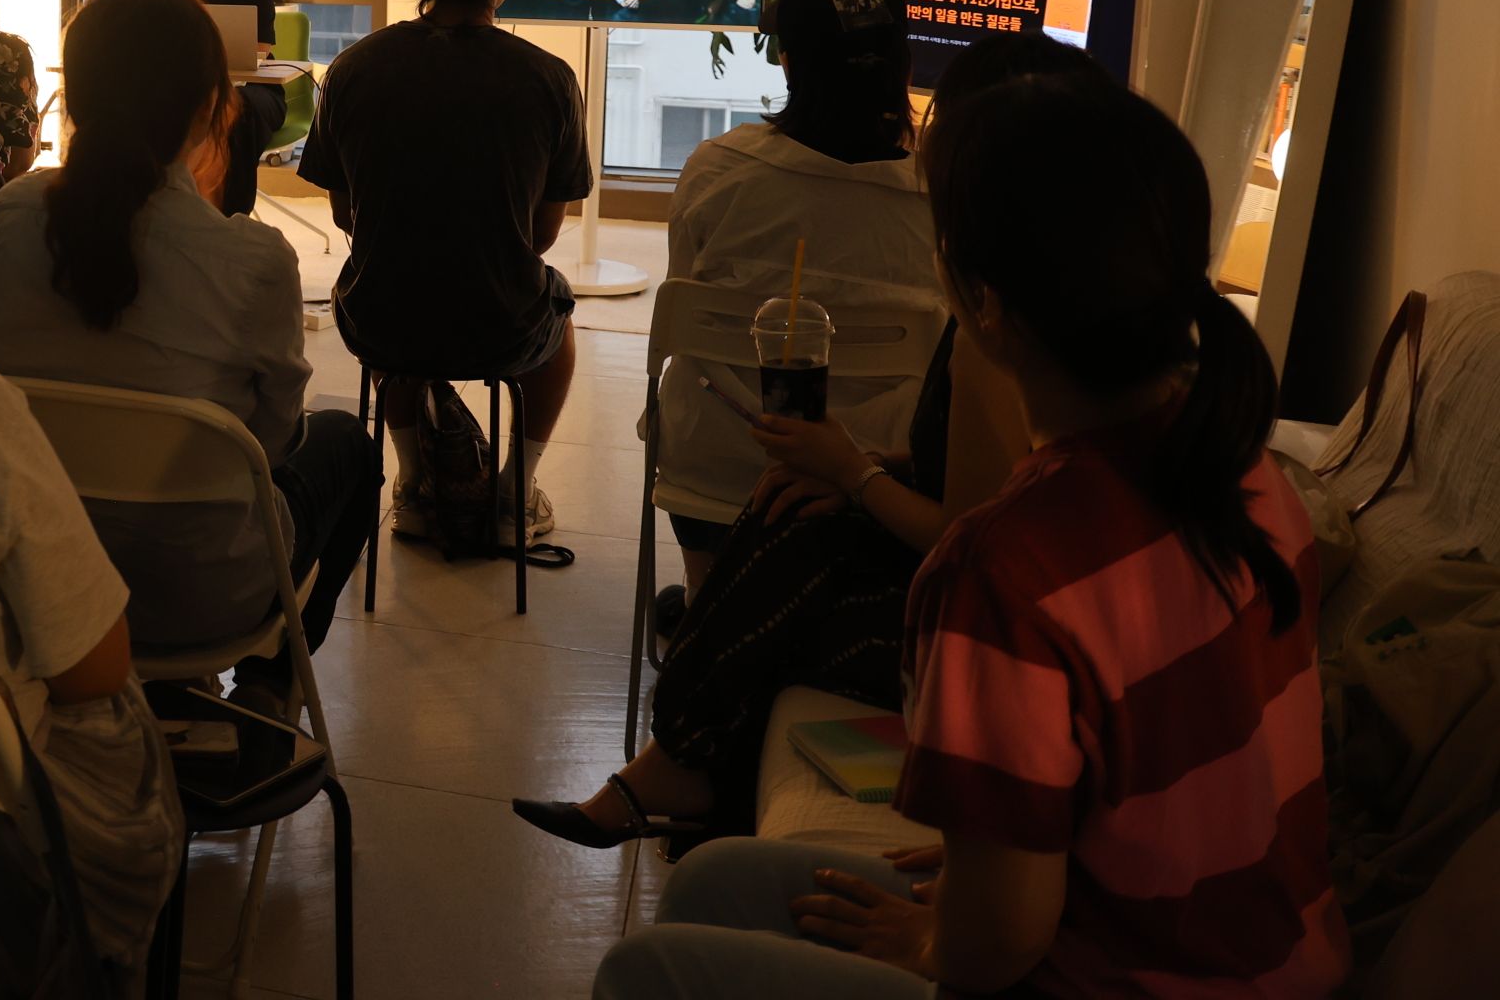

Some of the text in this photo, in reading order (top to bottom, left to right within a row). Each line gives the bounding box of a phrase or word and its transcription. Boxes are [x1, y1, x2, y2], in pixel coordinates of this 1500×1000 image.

[935, 7, 958, 24] 일을
[960, 11, 984, 27] 만든
[986, 14, 1022, 32] 질문들
